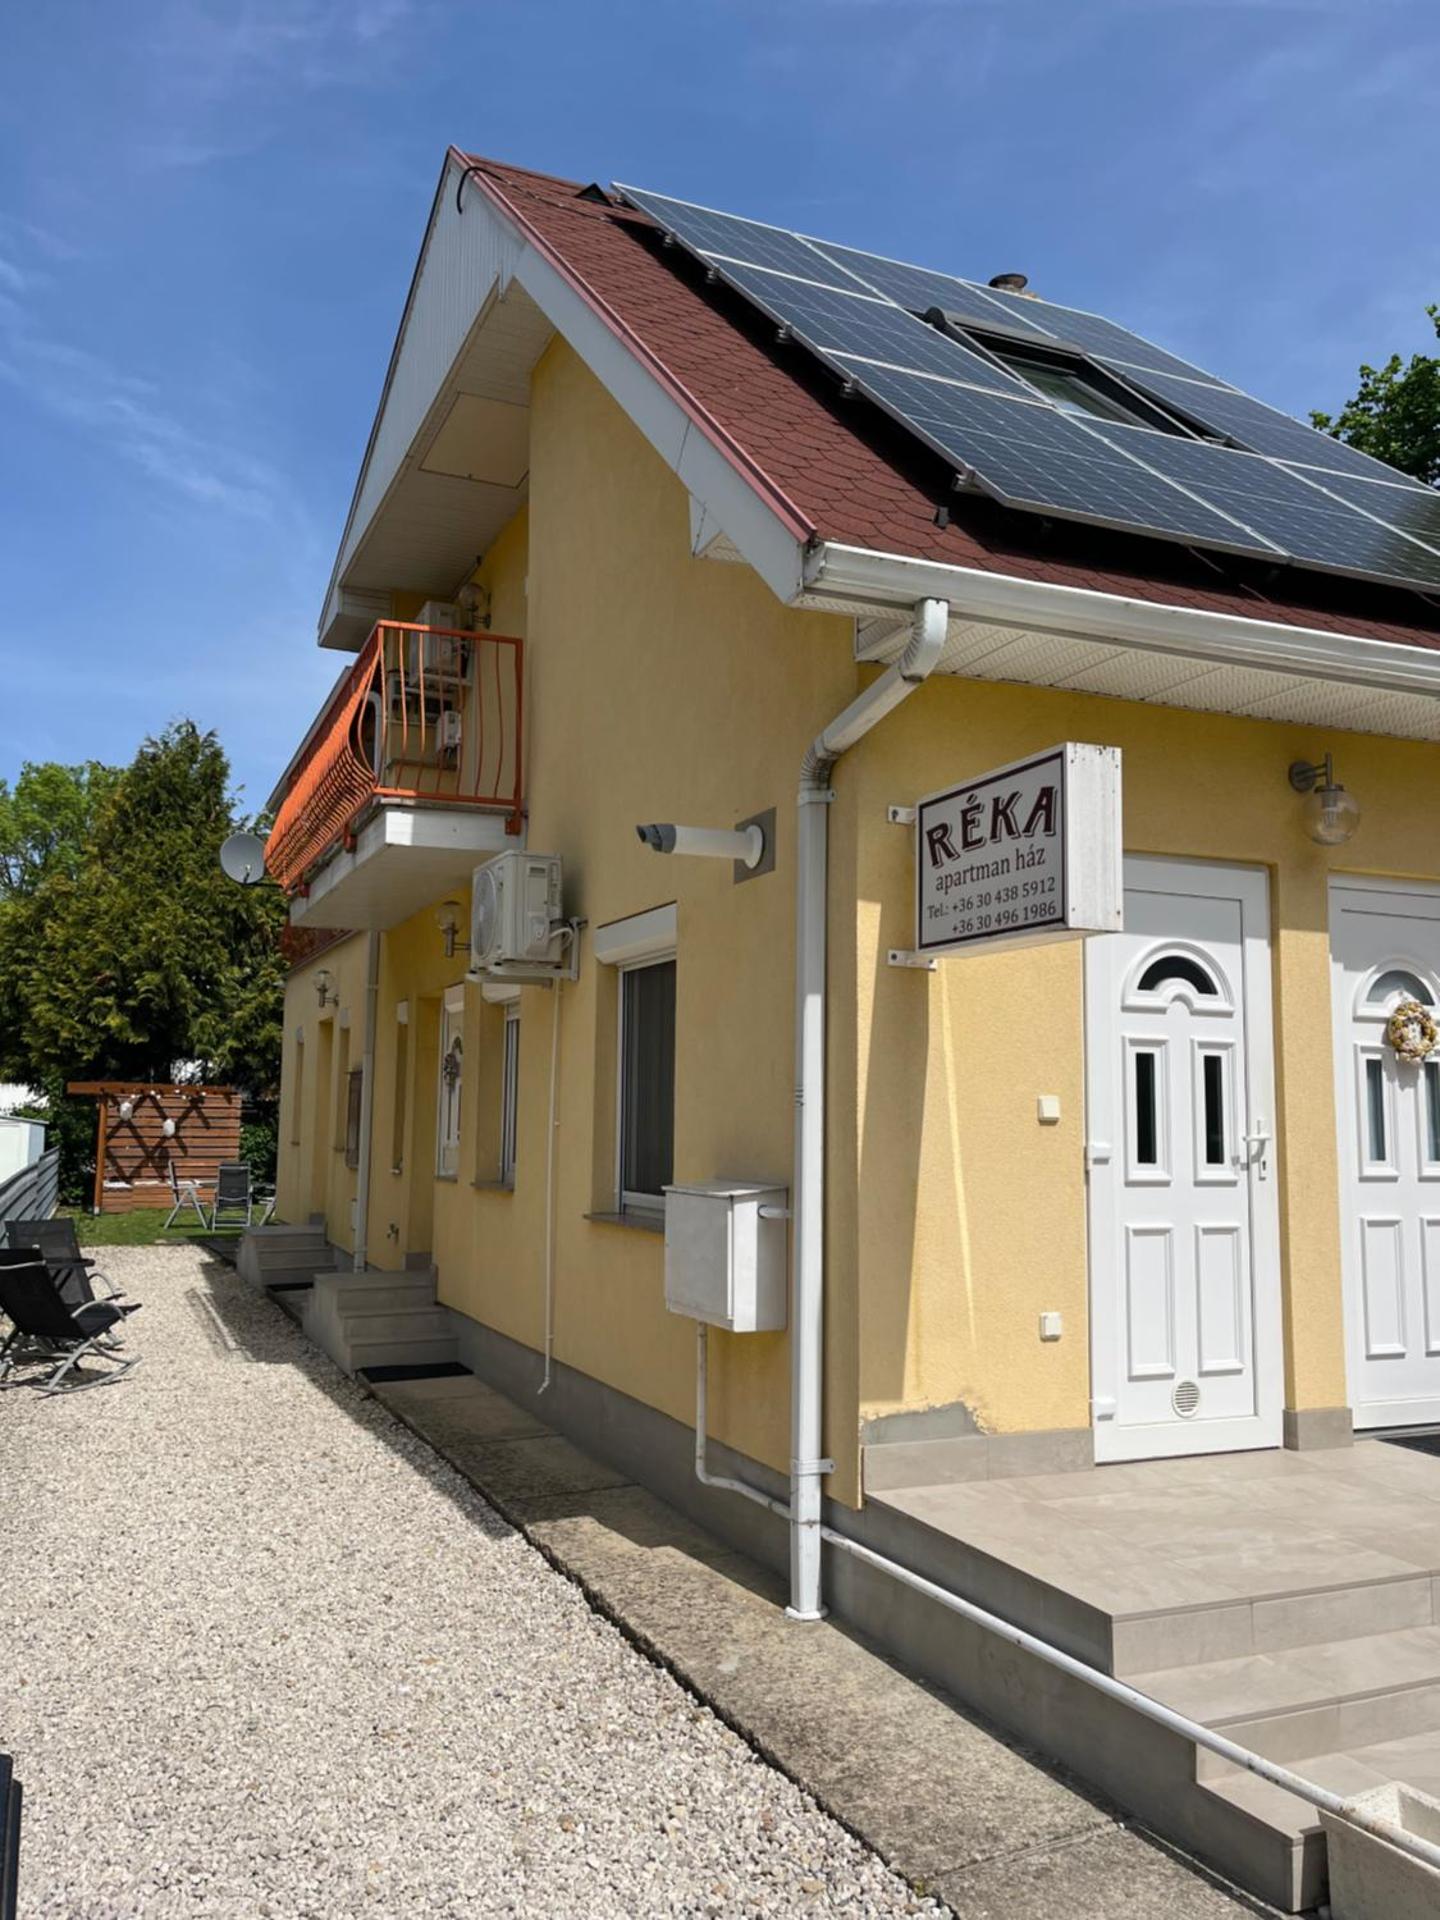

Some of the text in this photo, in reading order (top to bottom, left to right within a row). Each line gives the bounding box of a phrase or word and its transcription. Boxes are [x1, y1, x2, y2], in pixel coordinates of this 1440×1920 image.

[926, 786, 1058, 869] RÉKA
[935, 843, 1046, 895] apartman ház
[928, 877, 1055, 919] Tel.: +36 30 438 5912
[953, 901, 1056, 934] +36 30 496 1986
